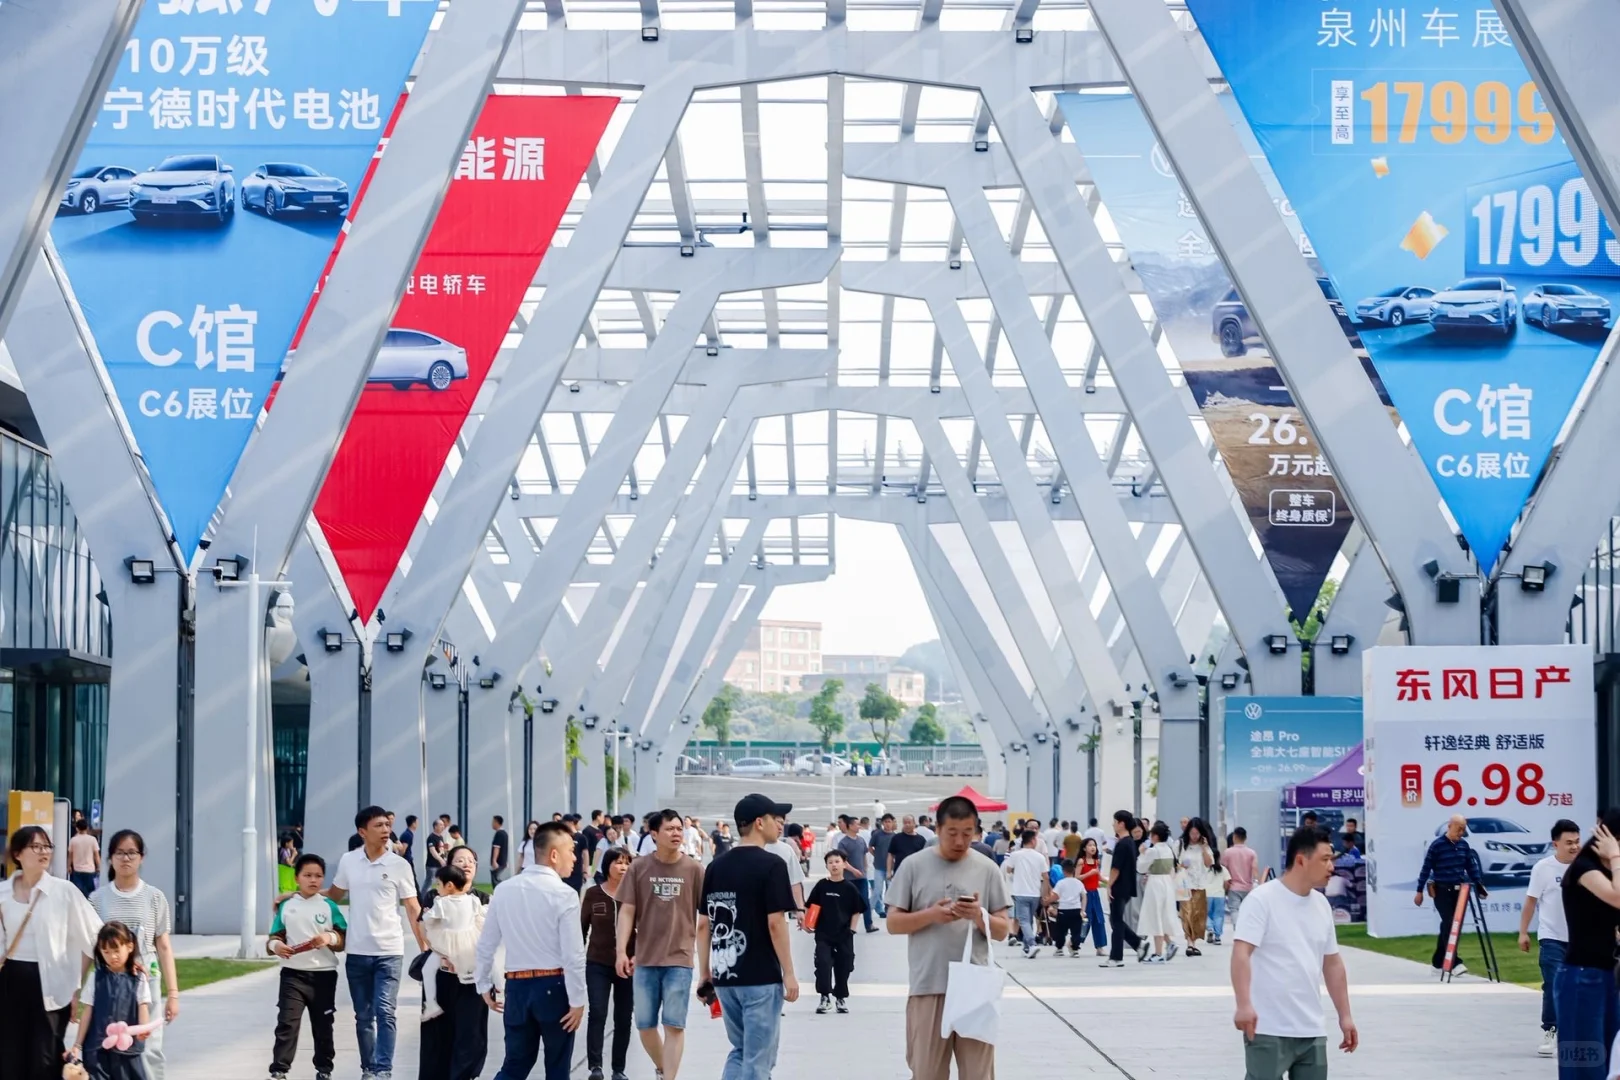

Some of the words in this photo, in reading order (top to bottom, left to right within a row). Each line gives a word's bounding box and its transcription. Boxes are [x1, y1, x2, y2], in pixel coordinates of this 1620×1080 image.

[1317, 8, 1512, 48] 泉州车展
[125, 35, 270, 76] 10万级
[92, 87, 381, 130] 宁德时代电池
[1335, 86, 1350, 140] 享至高
[136, 304, 257, 372] C馆
[139, 387, 253, 419] C6展位
[1433, 383, 1532, 440] C馆
[1436, 452, 1530, 479] C6展位
[1289, 494, 1315, 507] 整车
[1396, 666, 1571, 701] 东风日产
[1279, 731, 1300, 742] Pro
[1425, 735, 1490, 751] 轩逸经典
[1496, 734, 1545, 750] 舒适版
[1405, 770, 1418, 802] 一口价
[1433, 763, 1545, 807] 6.98
[1547, 793, 1573, 806] 万起
